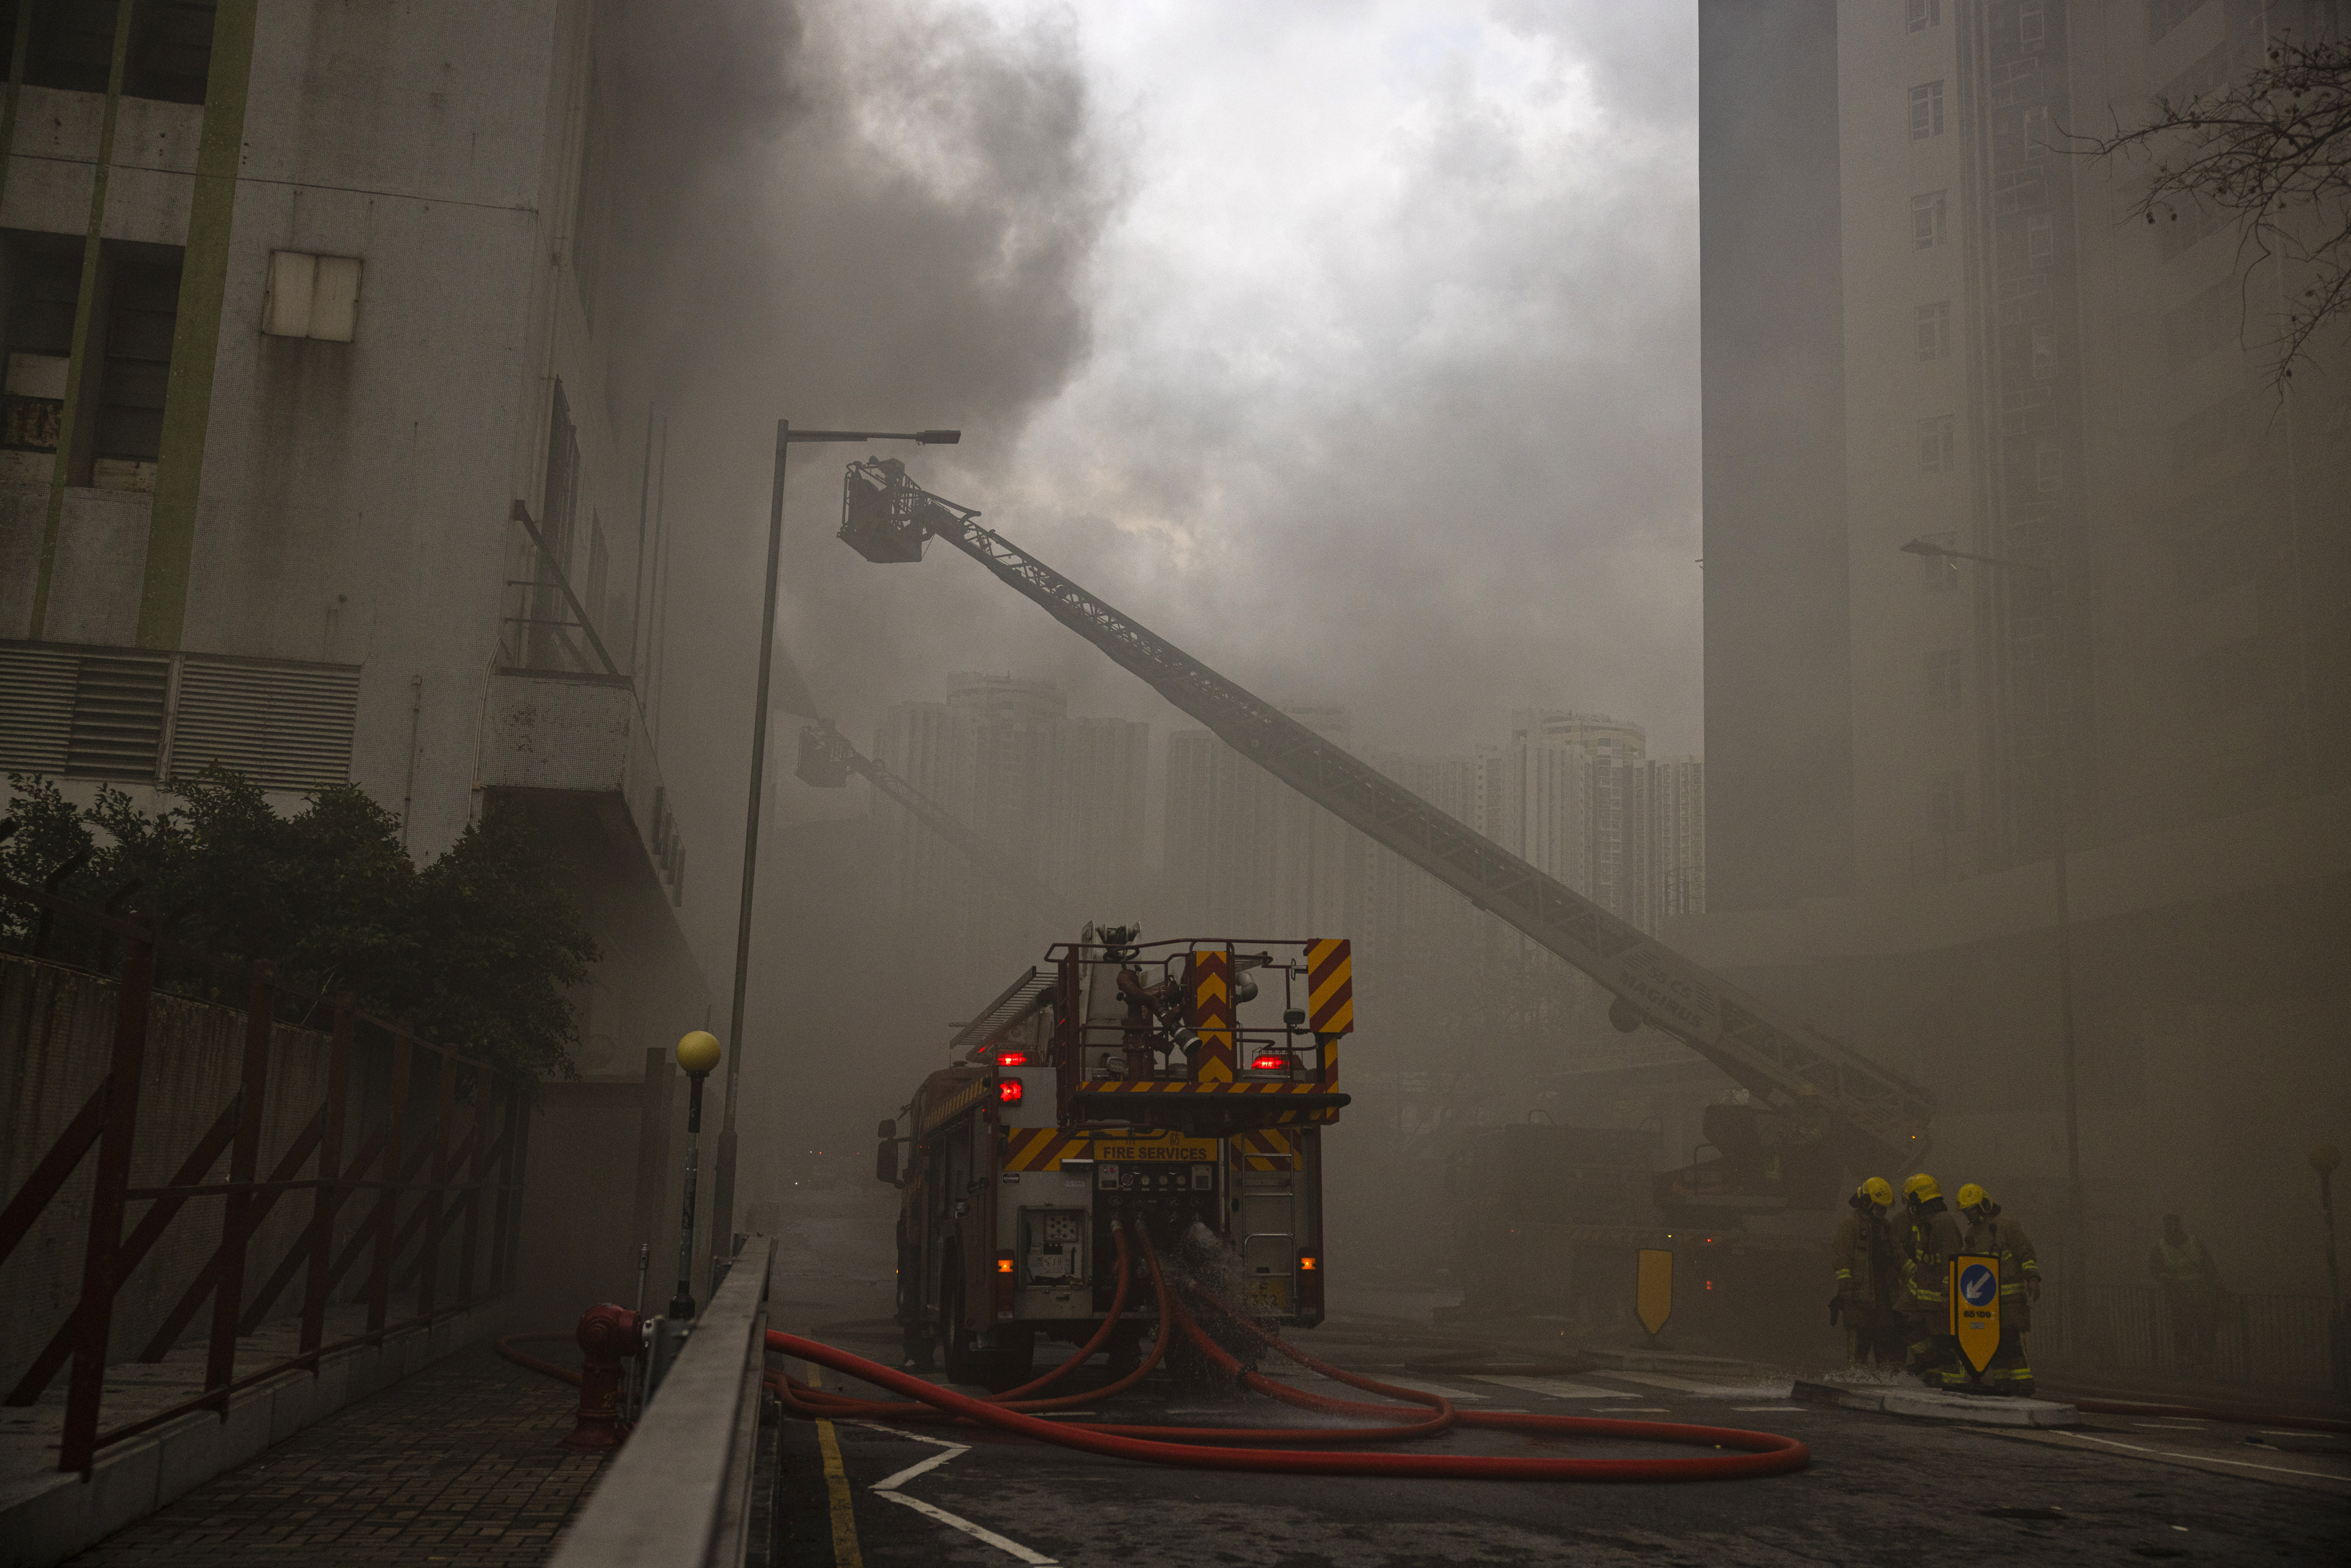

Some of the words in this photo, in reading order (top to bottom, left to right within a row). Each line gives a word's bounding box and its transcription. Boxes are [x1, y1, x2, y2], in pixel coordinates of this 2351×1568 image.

[1618, 970, 1704, 1027] MAGIRUS
[1170, 1132, 1180, 1146] 防
[1103, 1146, 1135, 1160] FIRE
[1138, 1147, 1207, 1161] SERVICES
